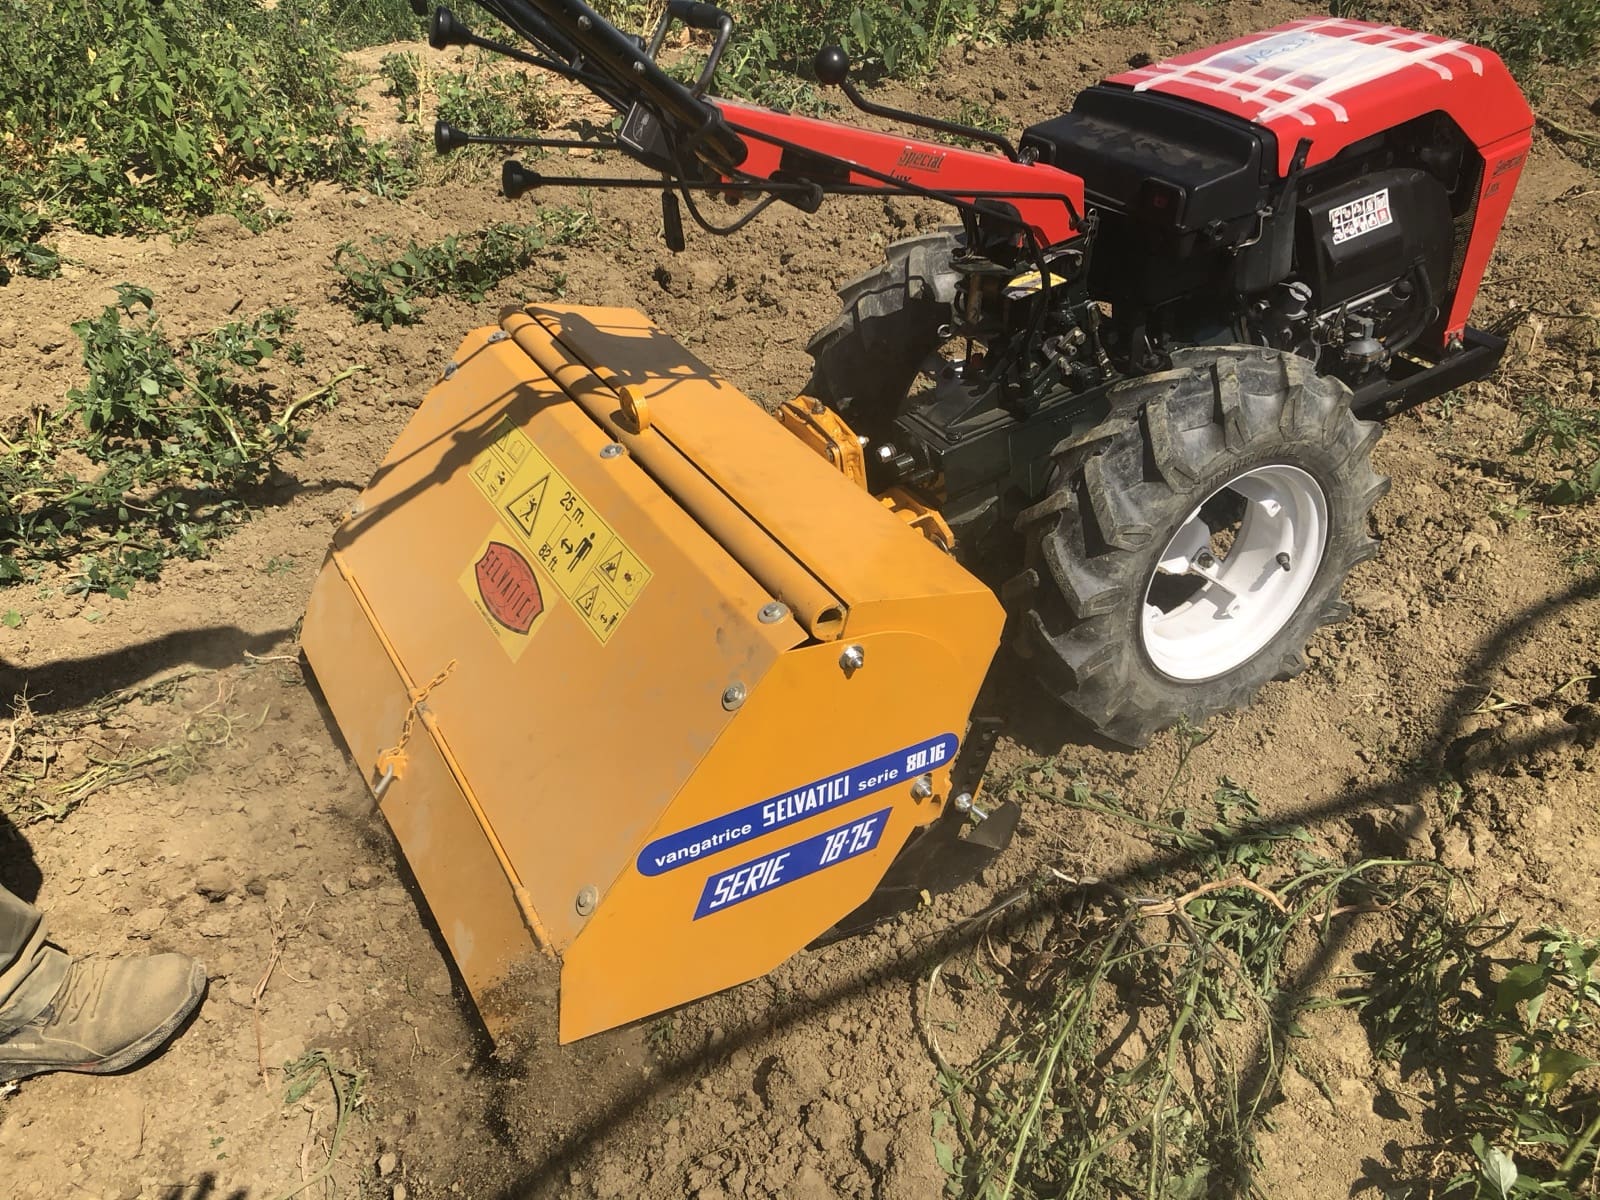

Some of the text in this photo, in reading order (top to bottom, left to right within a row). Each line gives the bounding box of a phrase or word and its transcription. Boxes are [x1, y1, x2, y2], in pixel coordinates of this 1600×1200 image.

[560, 491, 585, 528] 25 m.
[538, 544, 559, 573] 82 ft.
[480, 550, 537, 625] SELVATICI
[655, 742, 946, 867] vangatrice SELVATICI serie 80.16
[709, 852, 791, 909] SERIE
